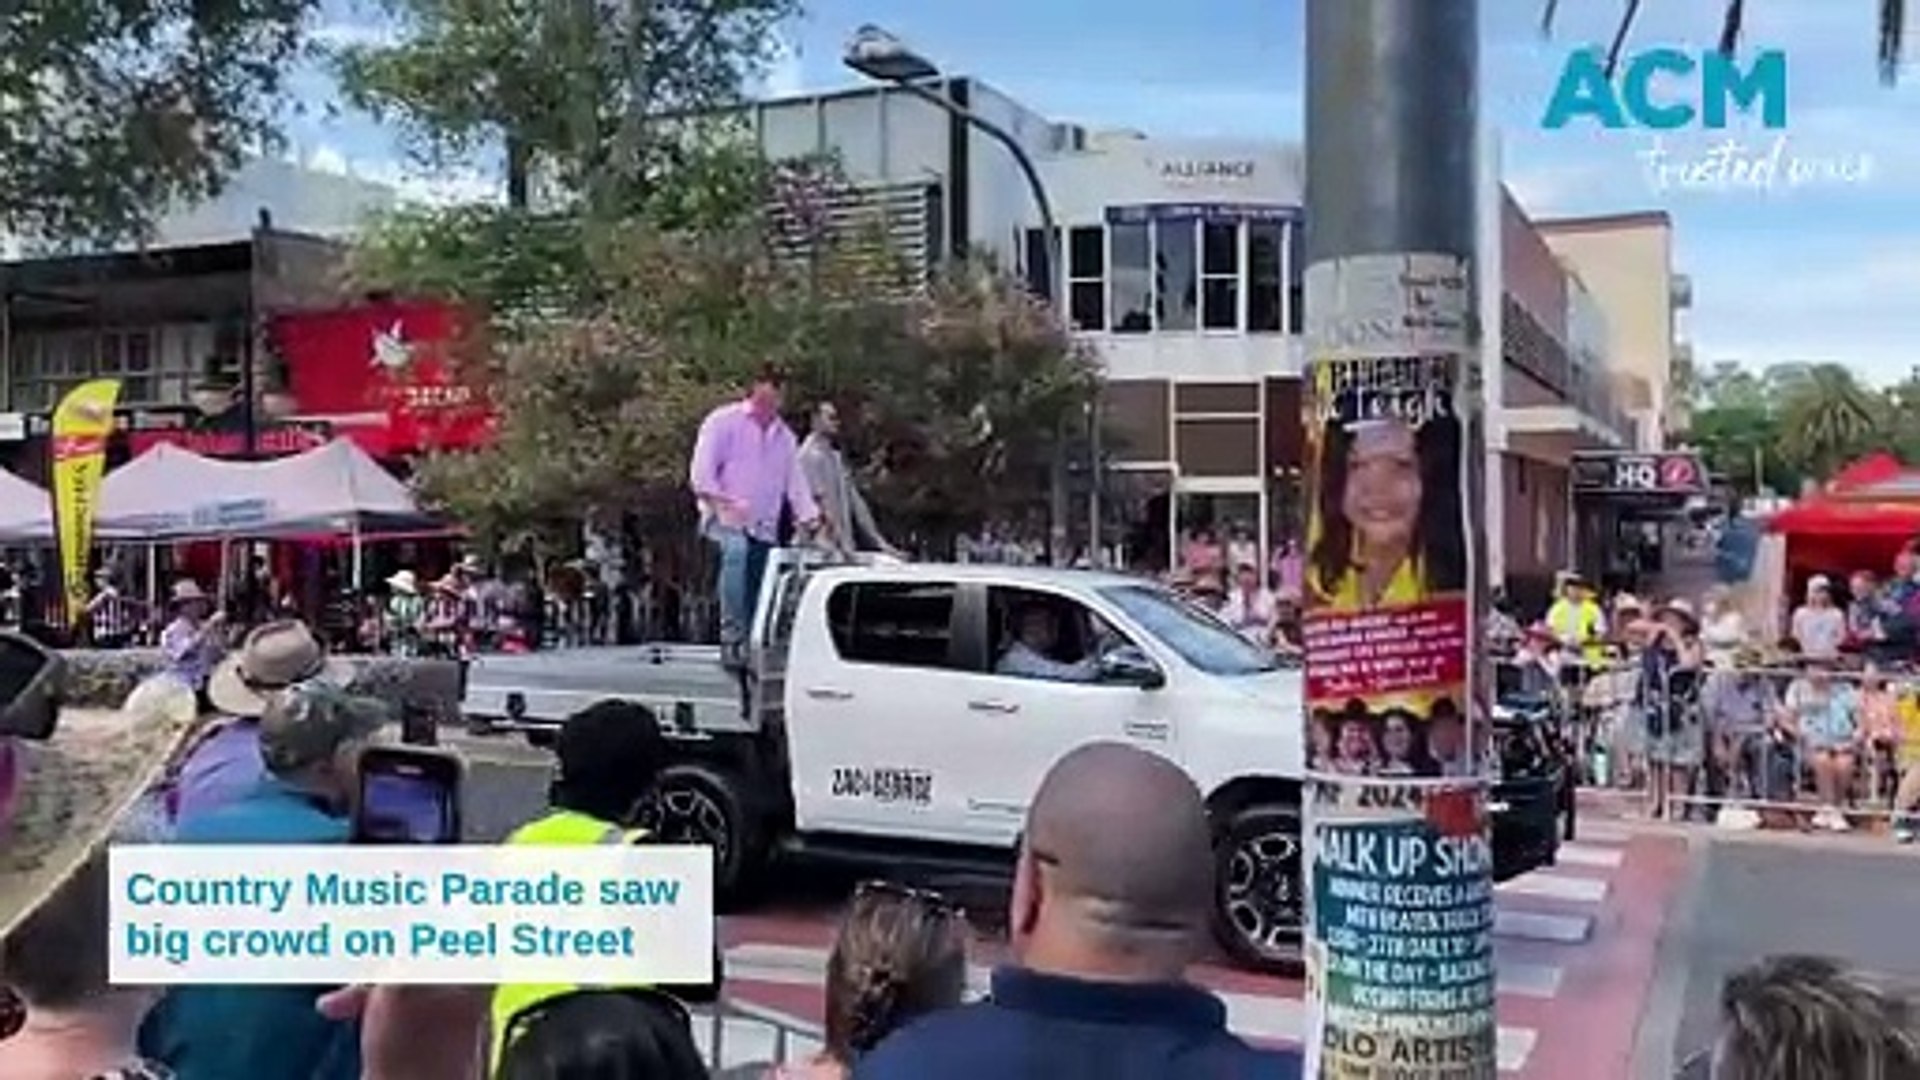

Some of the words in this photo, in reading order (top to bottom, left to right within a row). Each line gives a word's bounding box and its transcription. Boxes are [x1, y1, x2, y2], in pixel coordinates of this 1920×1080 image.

[1161, 161, 1255, 177] ALLIANCE
[1615, 463, 1656, 488] HQ
[1357, 783, 1424, 807] 2024
[1386, 835, 1427, 877] UP
[1383, 884, 1452, 907] RECEIVES
[1324, 1024, 1377, 1058] OLO
[1391, 1036, 1482, 1064] ARTIS
